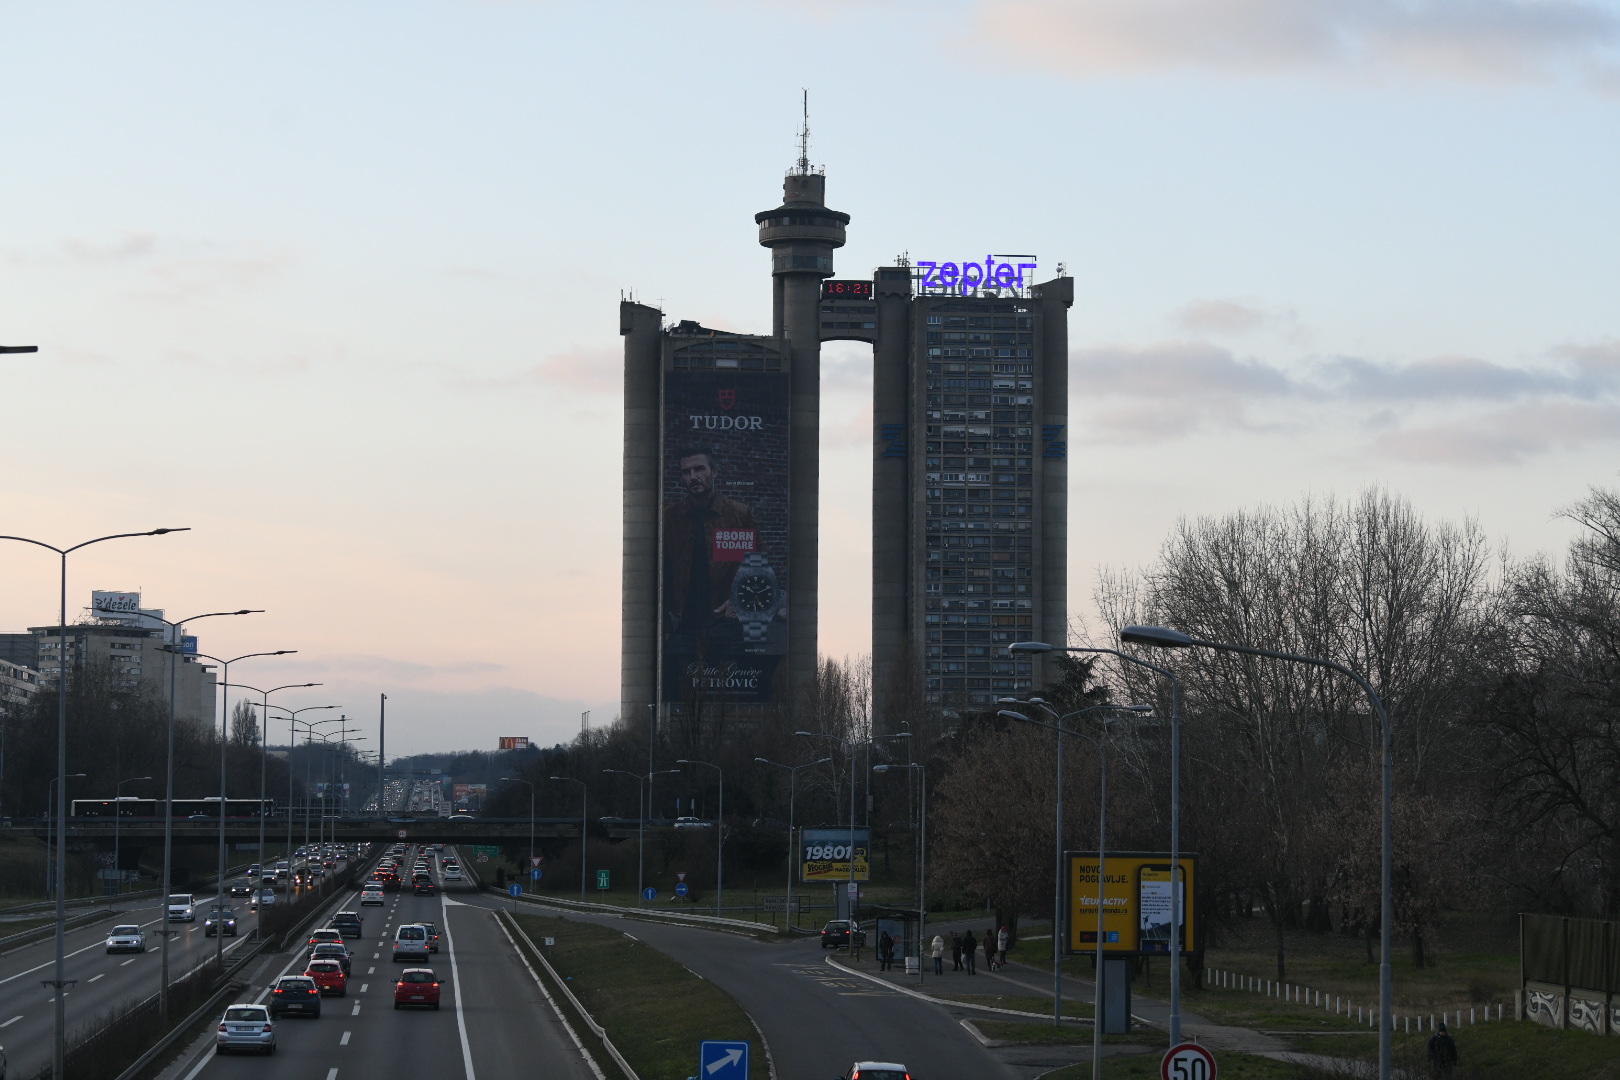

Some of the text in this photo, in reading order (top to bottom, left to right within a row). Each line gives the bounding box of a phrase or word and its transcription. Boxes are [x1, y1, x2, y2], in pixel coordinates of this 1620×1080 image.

[917, 254, 1037, 296] zepter
[828, 283, 869, 294] 16:21
[689, 415, 764, 430] TUDOR
[715, 531, 754, 541] #BORN
[1173, 1057, 1206, 1080] 50
